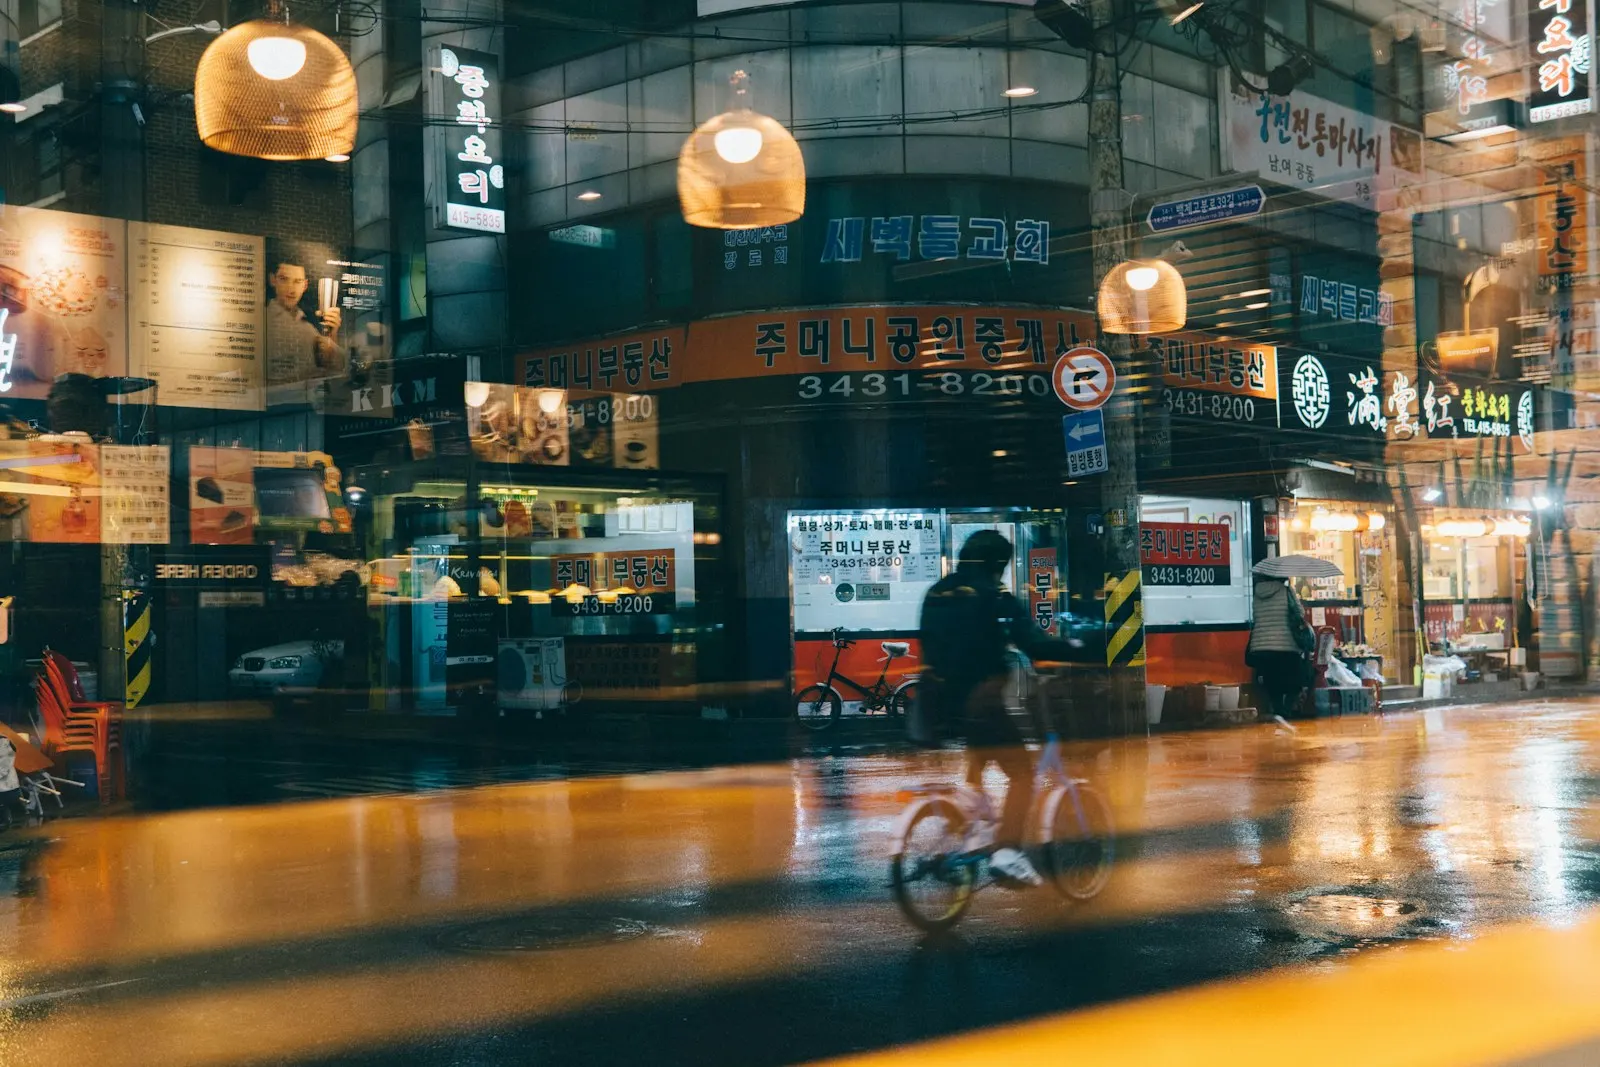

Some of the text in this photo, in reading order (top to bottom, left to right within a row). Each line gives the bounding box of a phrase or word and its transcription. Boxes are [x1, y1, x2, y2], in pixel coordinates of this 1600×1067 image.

[1537, 0, 1576, 97] 요리
[454, 65, 492, 203] 중화요리
[451, 208, 501, 229] 415-5835
[819, 214, 1050, 265] 새벽들교회
[1300, 275, 1394, 327] 새벽들교회
[524, 336, 673, 390] 주머니부동산
[1147, 336, 1267, 391] 주머니부동산
[798, 373, 1050, 399] 3431-8200
[1163, 389, 1255, 422] 3431-8200
[1461, 388, 1510, 421] 중화요리
[1069, 448, 1104, 473] 일방통행
[820, 540, 911, 555] 주머니부동산
[1140, 529, 1223, 559] 주머니부동산
[556, 555, 670, 589] 주머니부동산
[831, 556, 902, 568] 3431-8200
[1151, 567, 1216, 584] 3431-8200
[571, 596, 653, 614] 3431-8200
